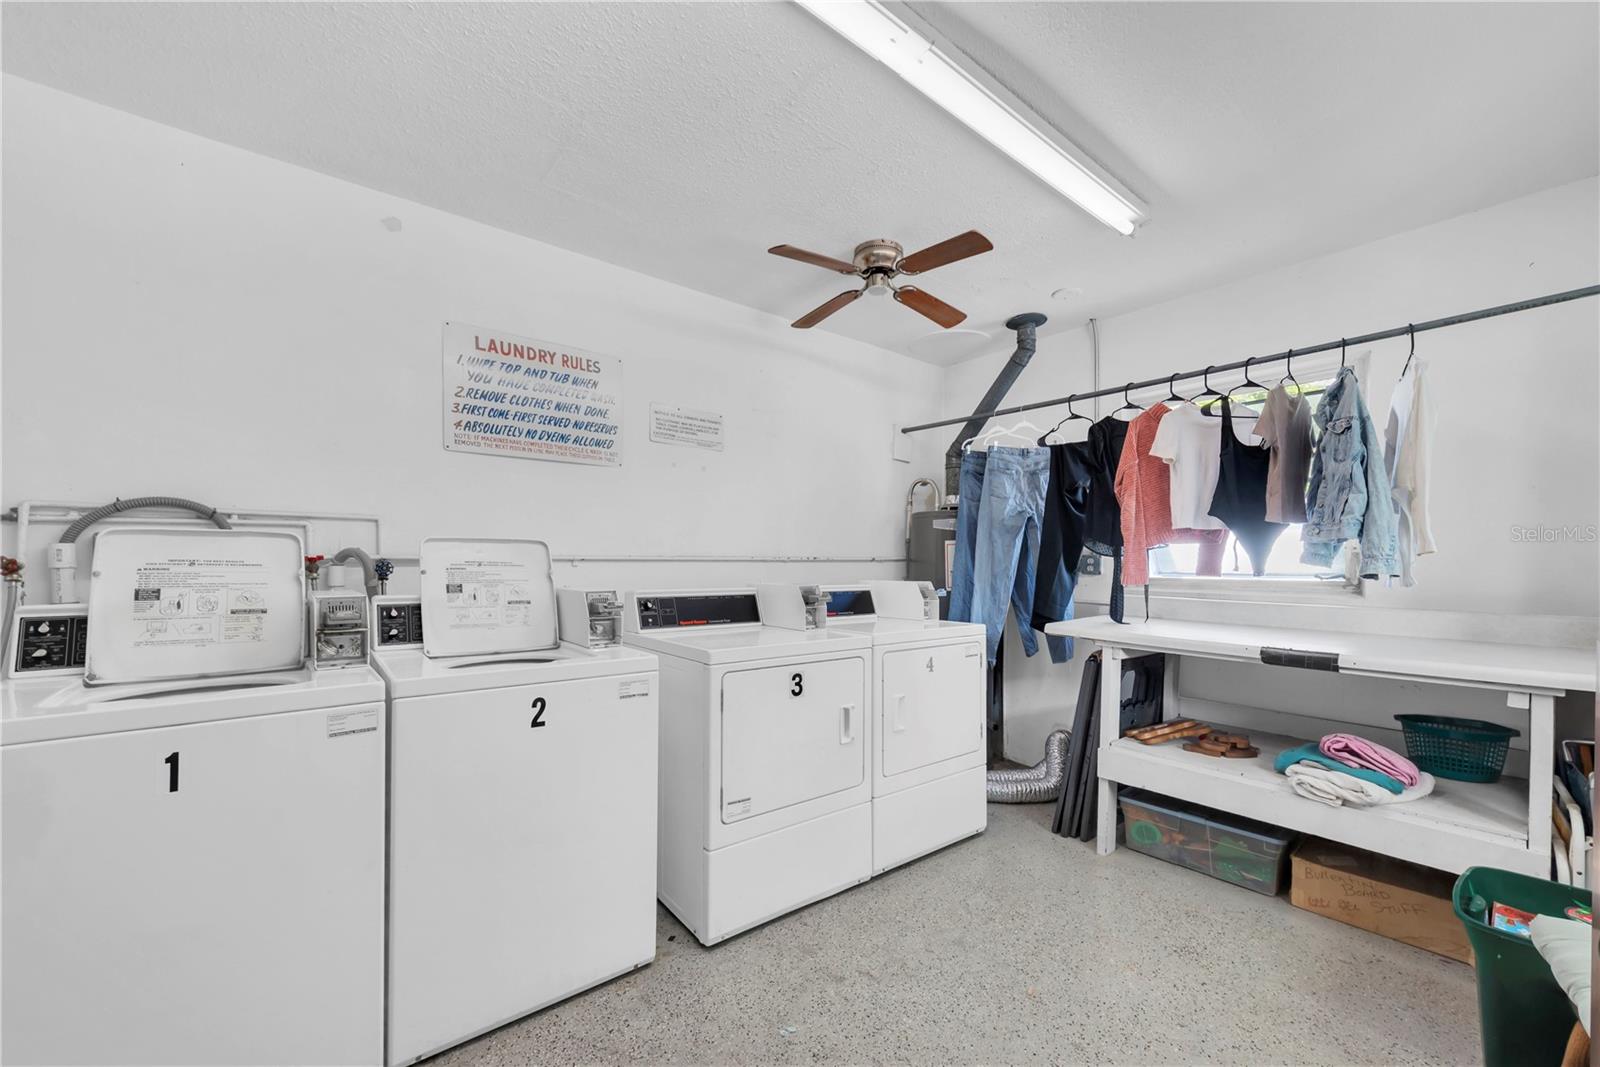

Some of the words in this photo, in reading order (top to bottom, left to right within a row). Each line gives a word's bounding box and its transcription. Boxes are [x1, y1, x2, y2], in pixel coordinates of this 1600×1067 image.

[475, 336, 556, 365] LAUNDRY
[562, 354, 600, 373] RULES
[467, 370, 492, 384] YOU
[500, 362, 522, 374] TOP
[523, 367, 548, 379] AND
[550, 371, 570, 384] TUB
[571, 376, 599, 390] WHEN
[510, 395, 553, 410] CLOTHES
[554, 401, 582, 415] WHEN
[525, 429, 538, 440] NO
[539, 430, 571, 444] DYEING
[572, 435, 615, 449] ALLOWED
[926, 656, 935, 672] 4
[790, 673, 803, 697] 3
[530, 698, 546, 729] 2
[164, 752, 180, 793] 1
